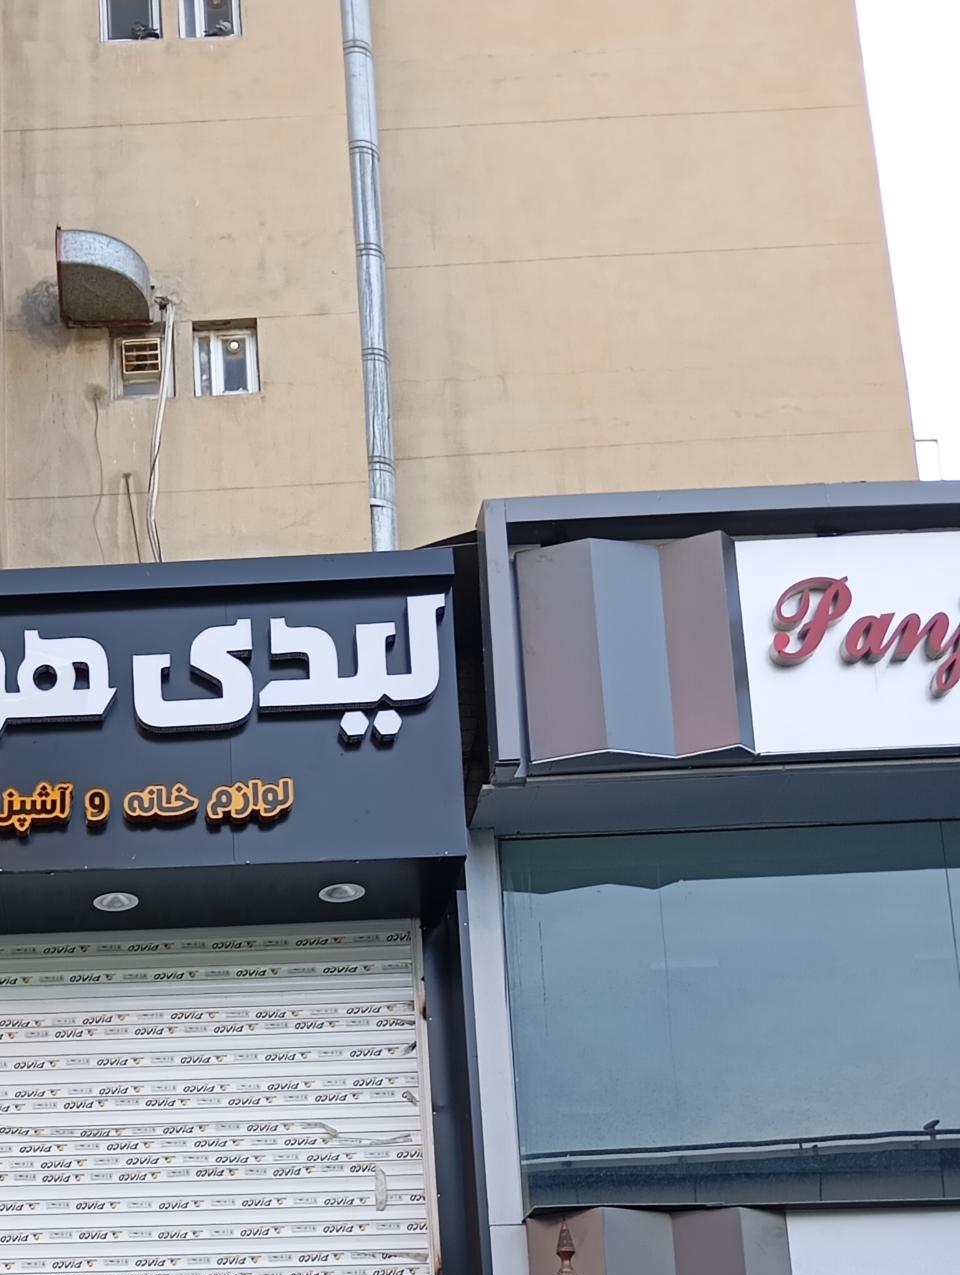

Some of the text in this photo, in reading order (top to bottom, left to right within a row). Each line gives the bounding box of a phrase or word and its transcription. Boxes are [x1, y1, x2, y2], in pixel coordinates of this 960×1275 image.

[132, 593, 446, 739] لیدی
[84, 786, 110, 824] و
[123, 783, 199, 821] خانه
[206, 776, 294, 820] لوازم
